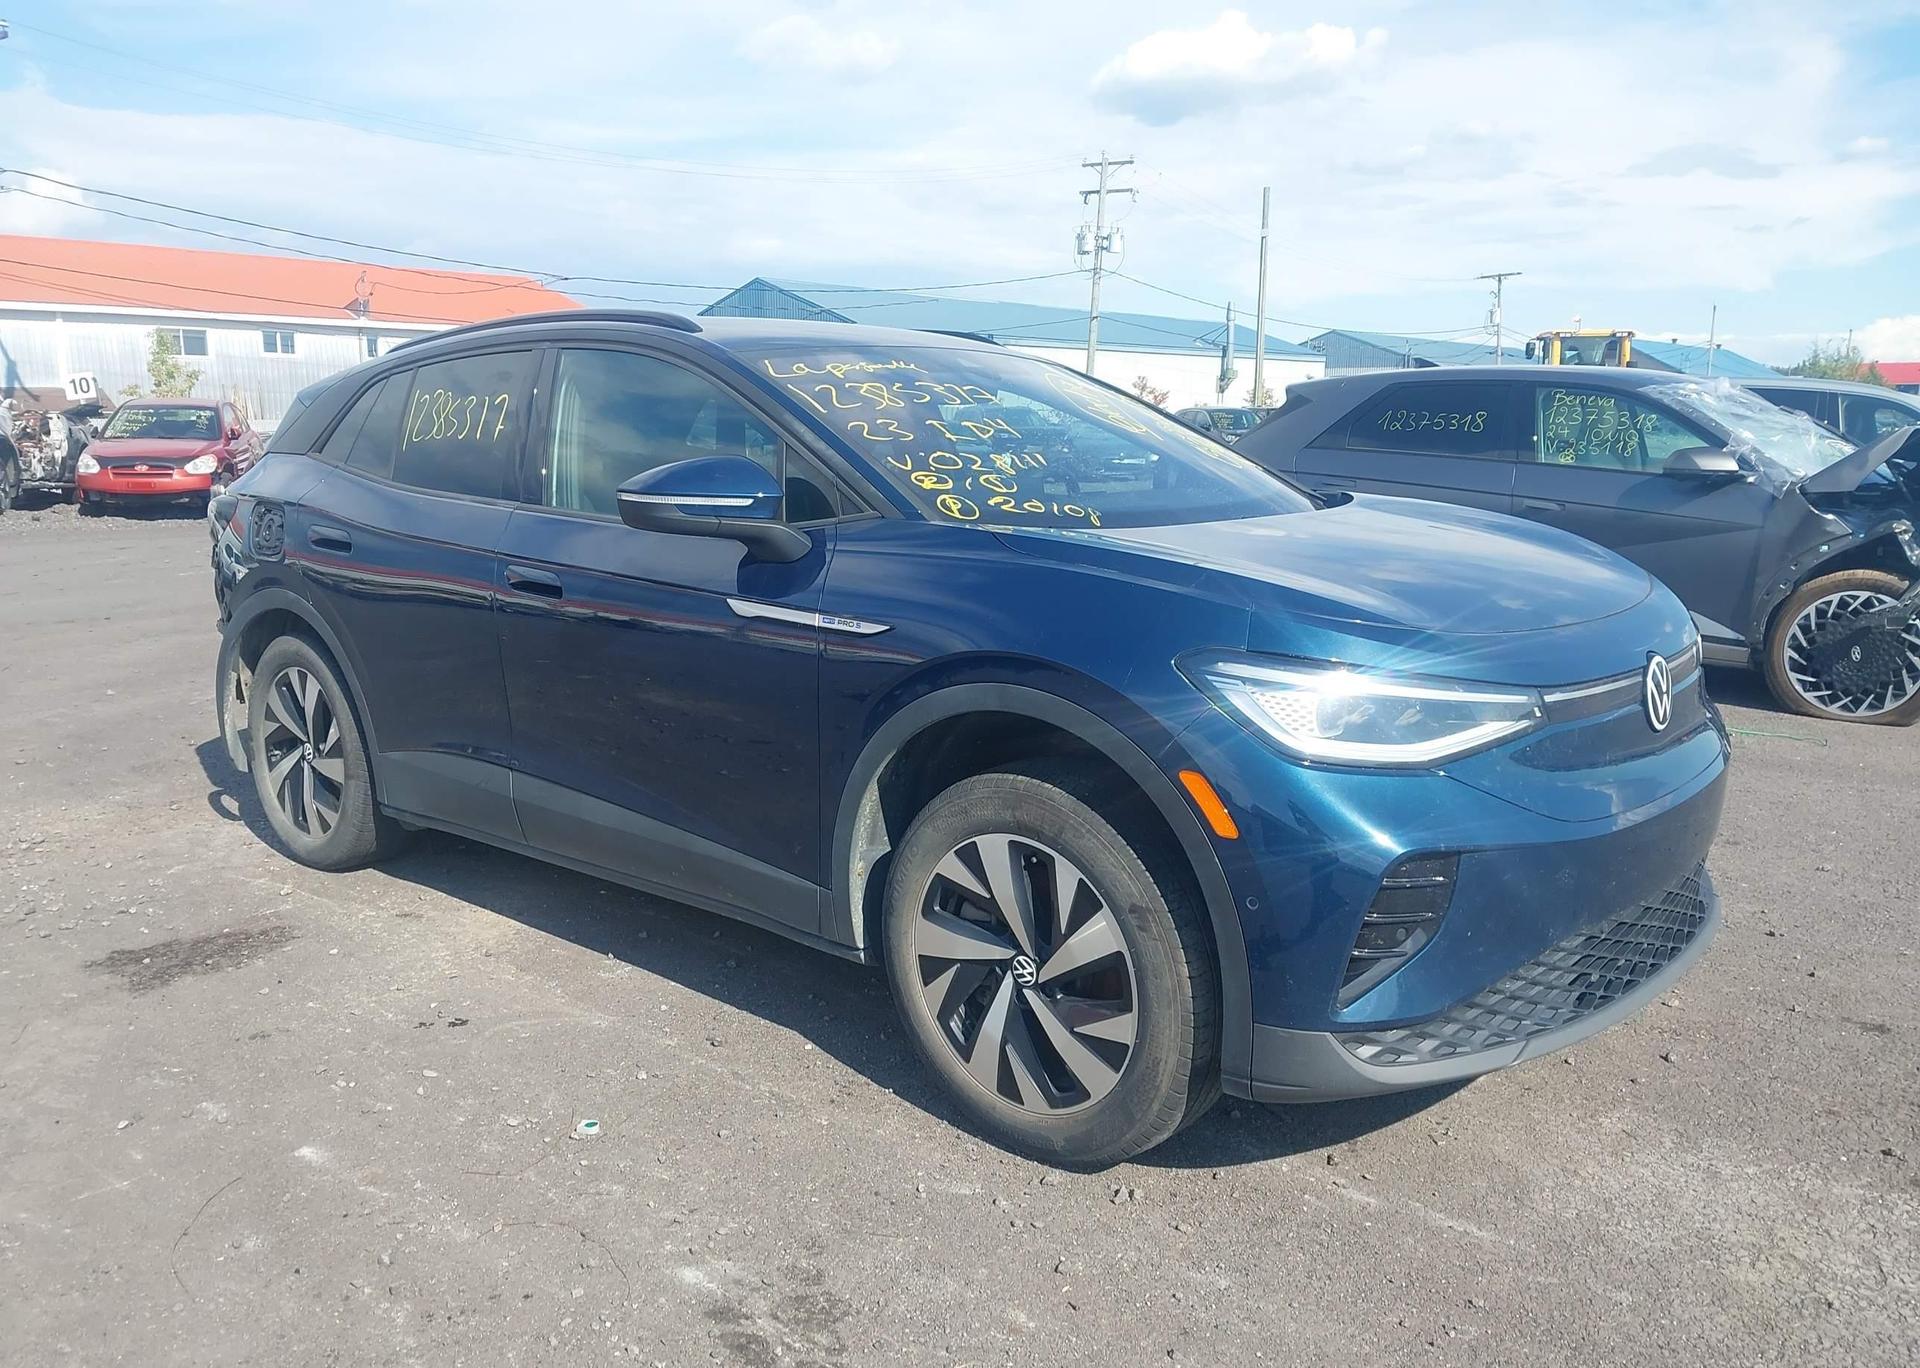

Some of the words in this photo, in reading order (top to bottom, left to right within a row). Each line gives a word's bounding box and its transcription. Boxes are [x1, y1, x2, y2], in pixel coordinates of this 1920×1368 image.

[69, 376, 91, 395] 10
[1551, 388, 1615, 408] Beneva
[402, 388, 509, 452] 12385317
[848, 418, 914, 441] 23
[1378, 409, 1488, 432] 12375318
[1545, 406, 1657, 432] 12375318
[1546, 424, 1570, 439] 24
[837, 618, 855, 628] PRO
